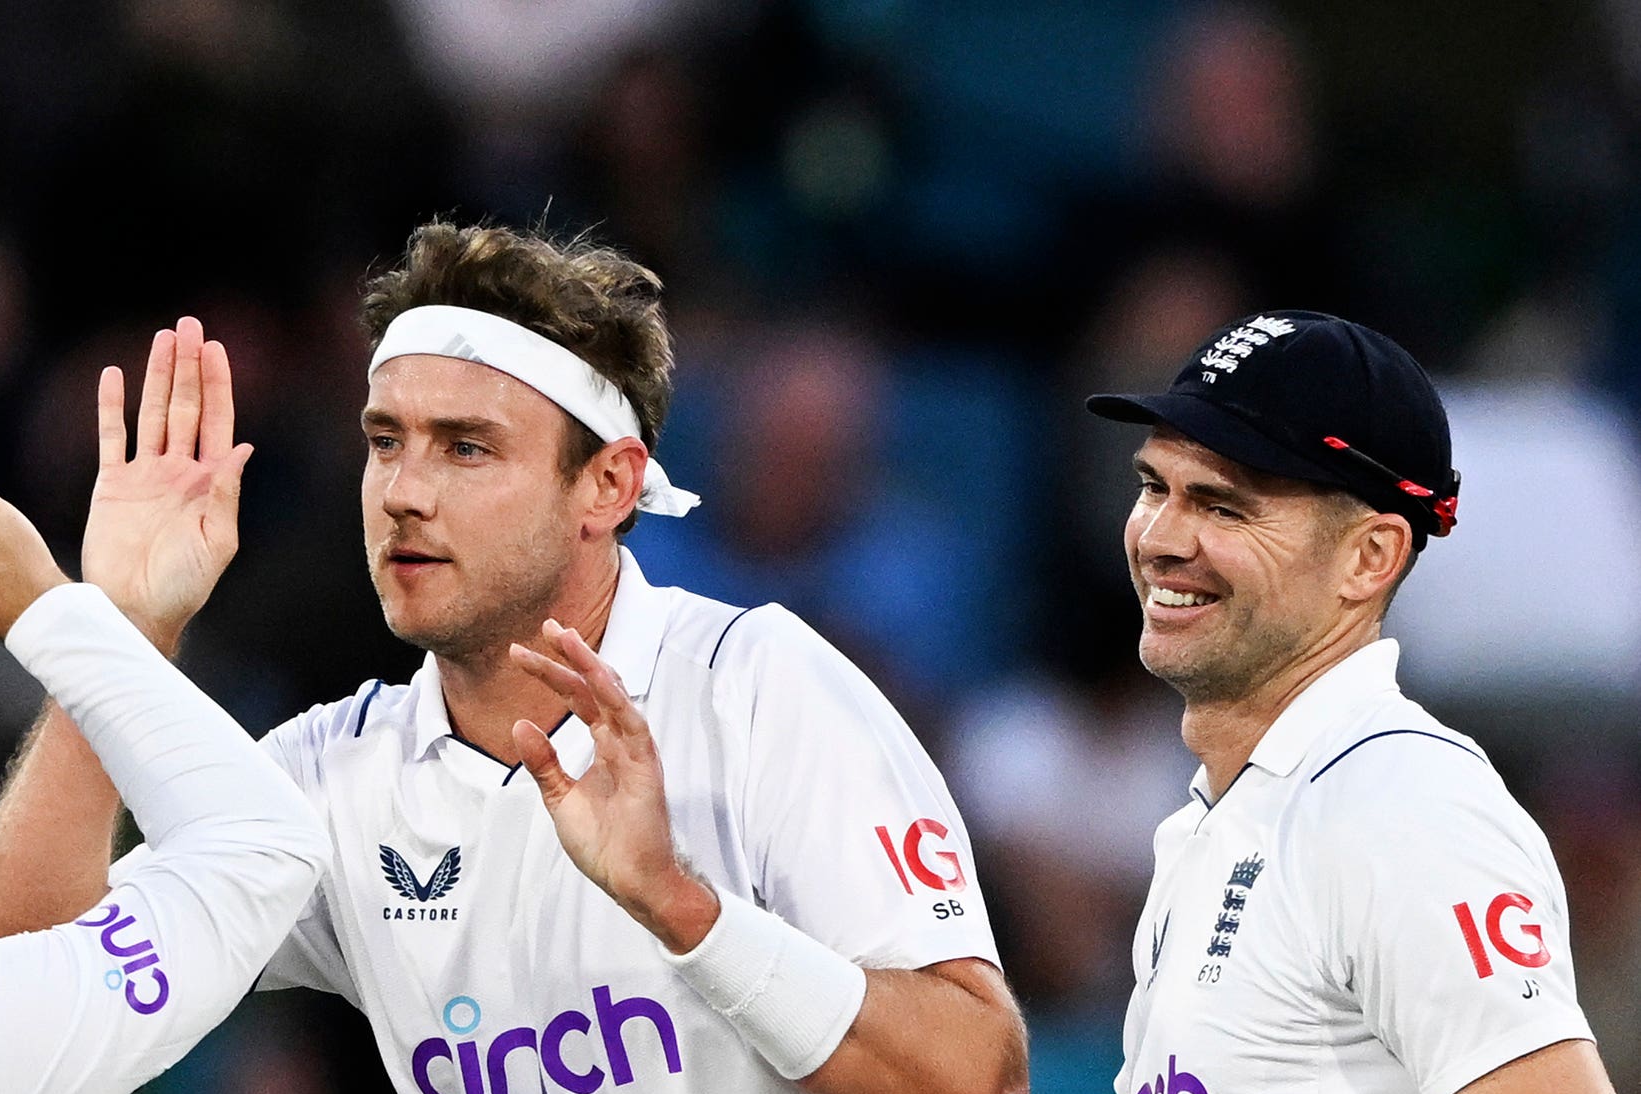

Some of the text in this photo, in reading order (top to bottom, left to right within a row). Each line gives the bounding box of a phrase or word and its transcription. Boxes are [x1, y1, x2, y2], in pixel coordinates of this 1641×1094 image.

[874, 817, 967, 896] IG
[383, 907, 458, 921] CASTORE
[932, 899, 965, 920] SB
[1452, 892, 1552, 979] IG
[1197, 963, 1222, 983] 613
